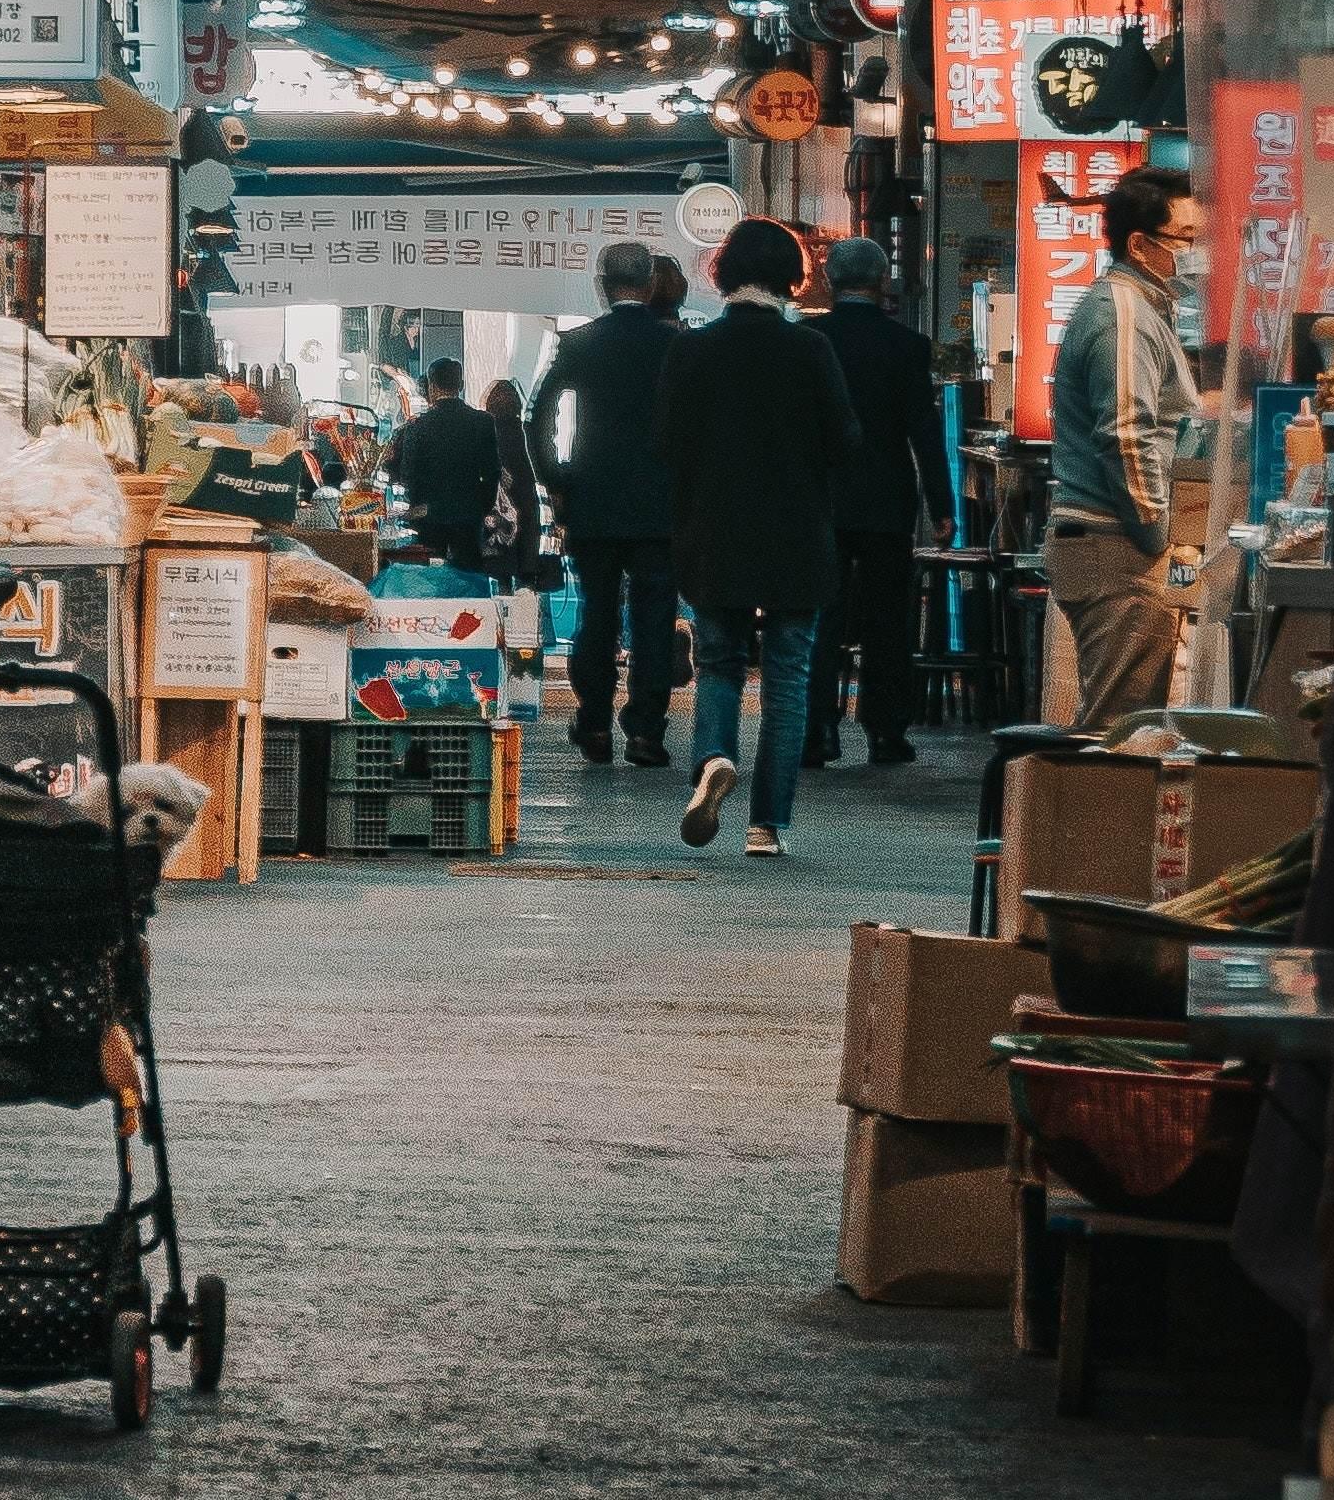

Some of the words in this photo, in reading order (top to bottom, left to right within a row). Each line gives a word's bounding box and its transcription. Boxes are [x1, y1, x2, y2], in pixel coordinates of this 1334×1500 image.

[945, 5, 1007, 60] 최초
[946, 61, 1007, 129] 원조
[214, 472, 254, 491] Zespri
[255, 479, 293, 493] Green
[164, 566, 238, 585] 무료시식
